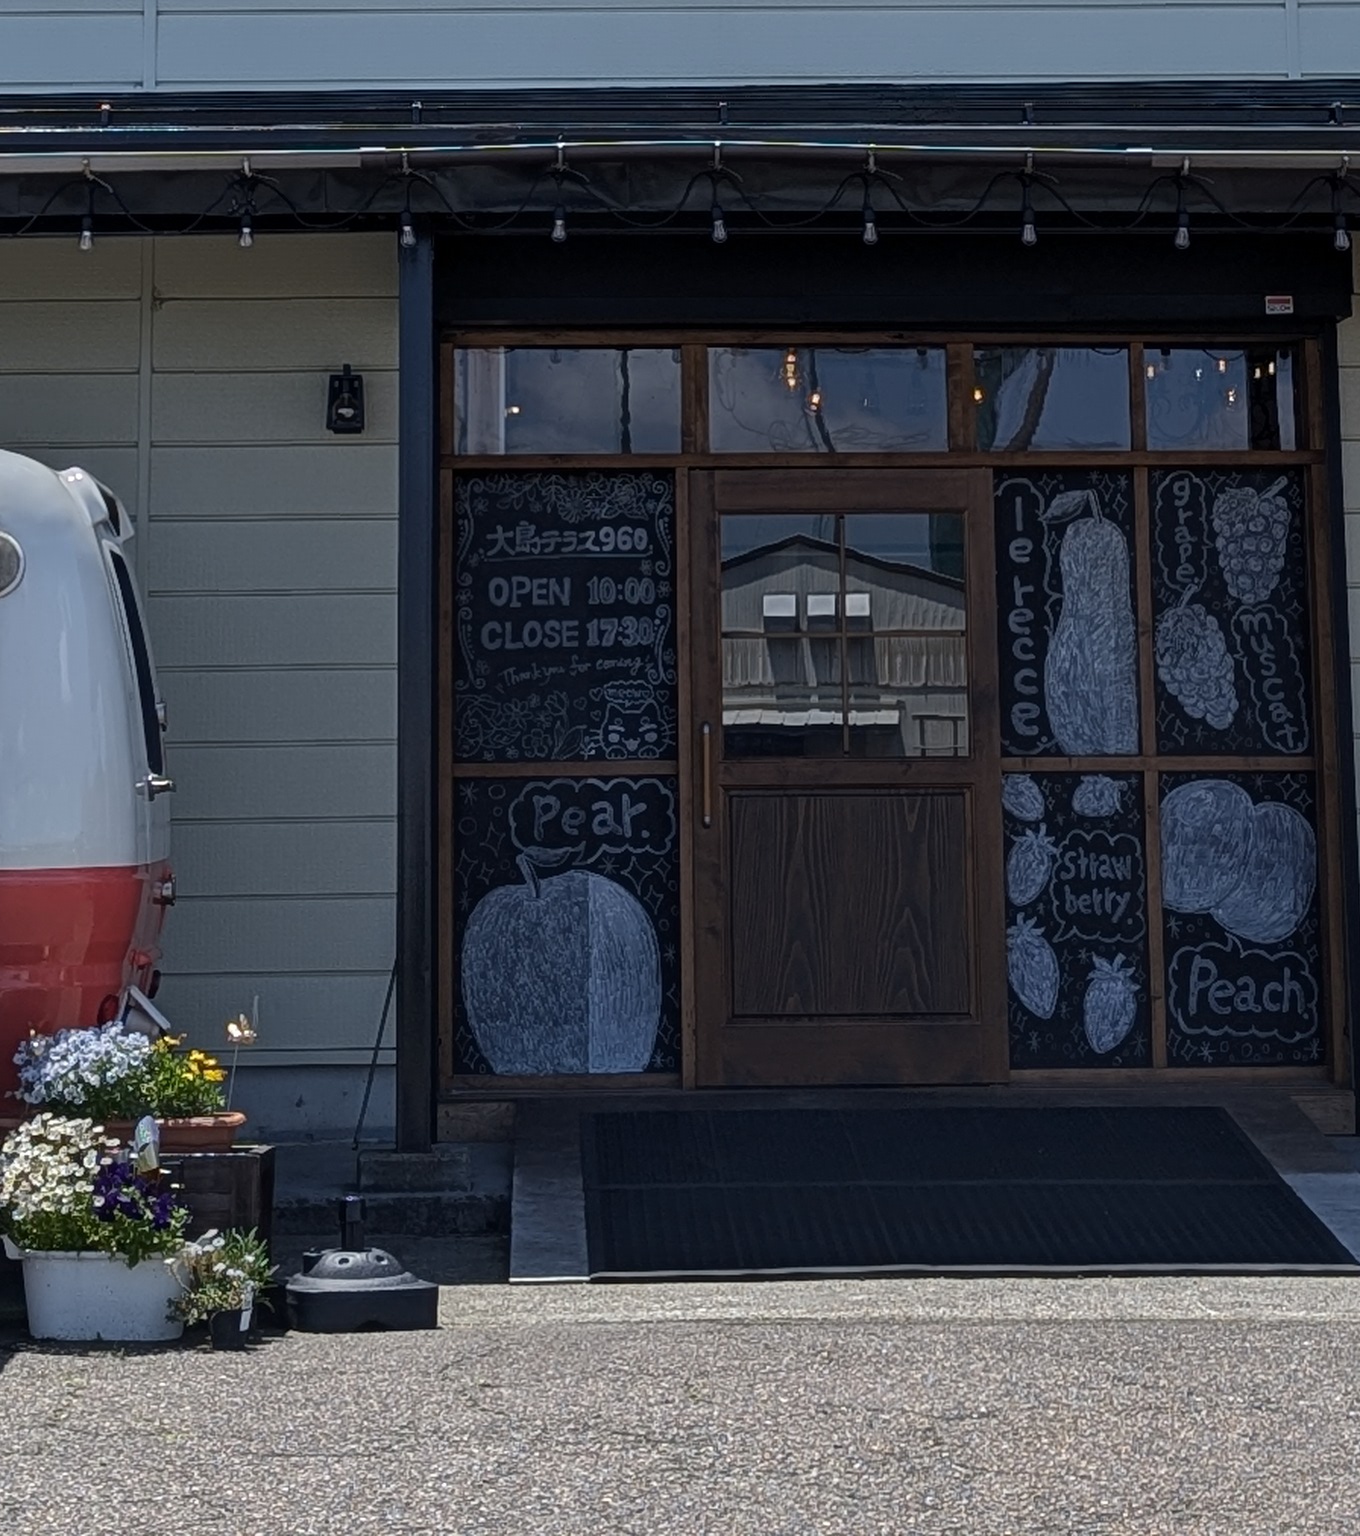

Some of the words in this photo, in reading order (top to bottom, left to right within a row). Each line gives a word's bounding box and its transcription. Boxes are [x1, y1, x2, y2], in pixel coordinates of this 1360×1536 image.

[486, 520, 648, 556] 大島テラス960
[488, 576, 572, 607] OPEN
[586, 576, 656, 606] 10:00
[480, 620, 580, 650] CLOSE
[585, 617, 655, 648] 17:30
